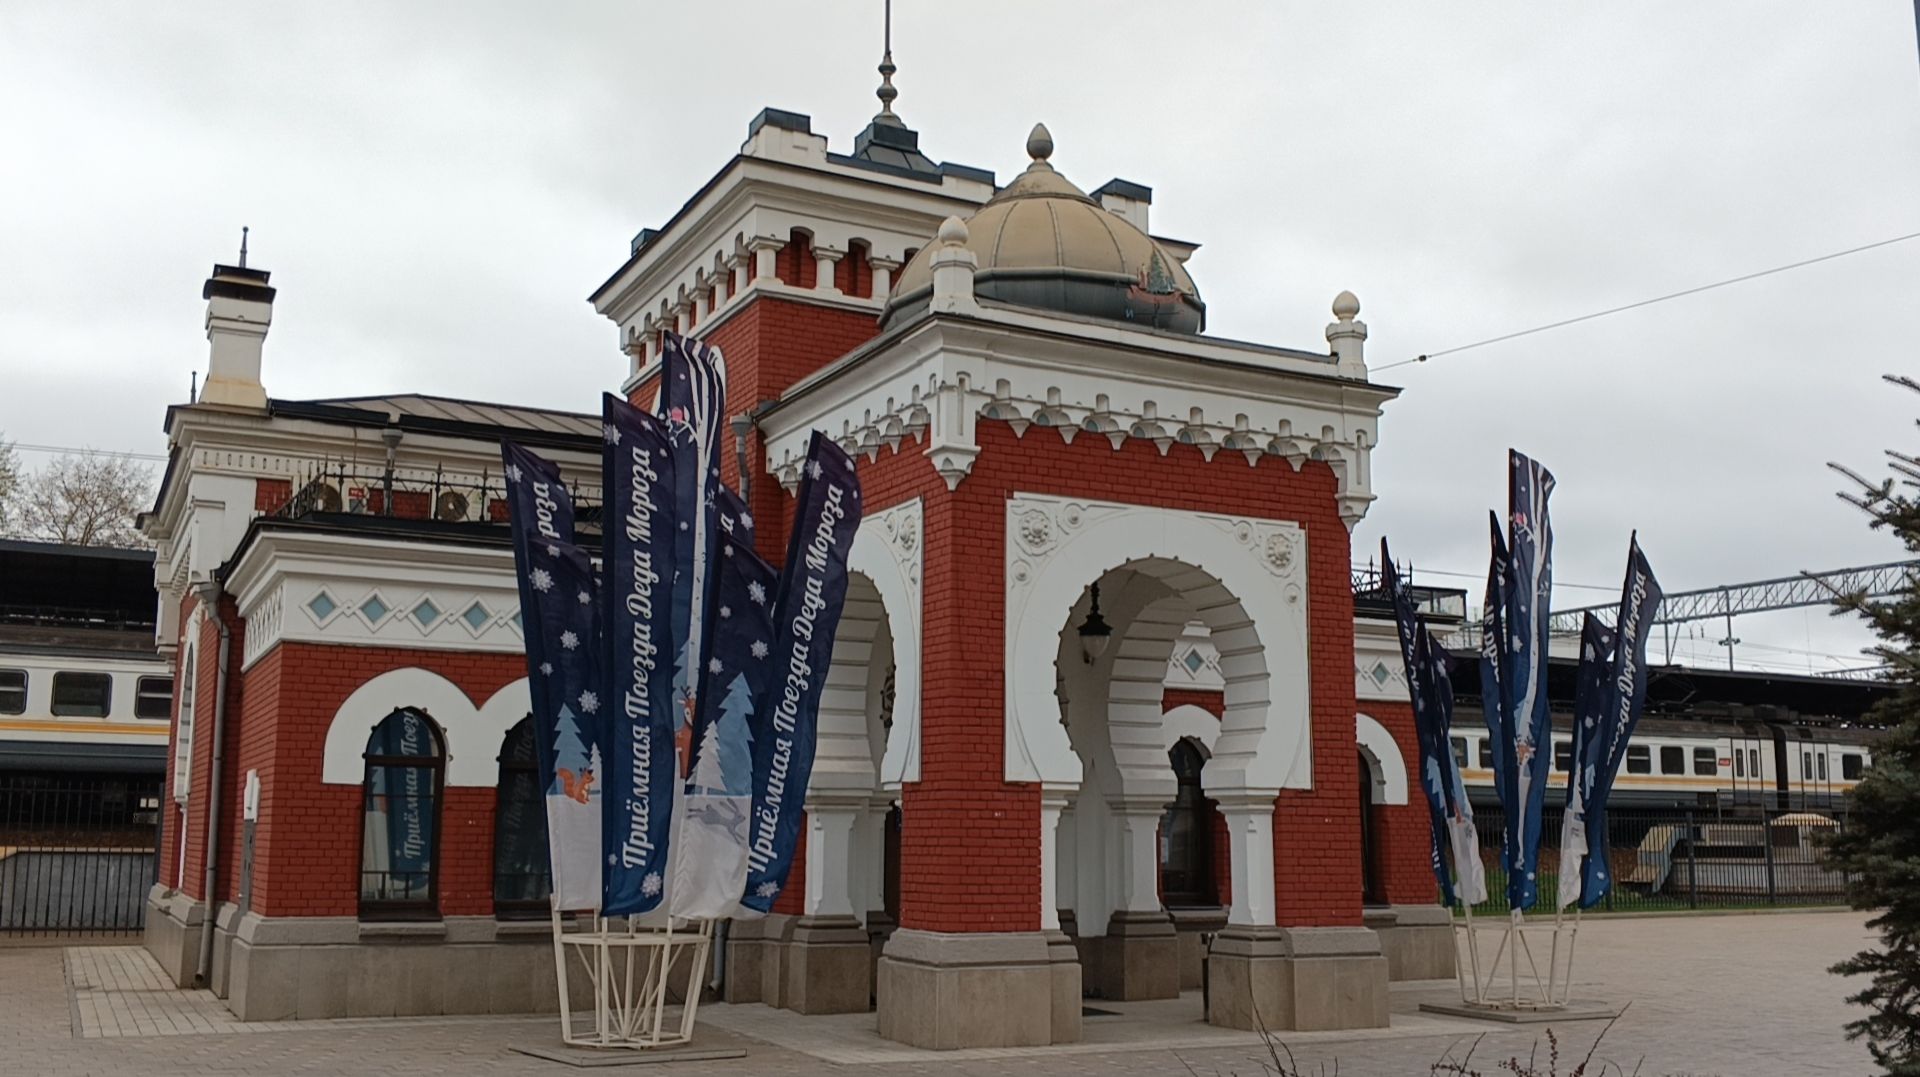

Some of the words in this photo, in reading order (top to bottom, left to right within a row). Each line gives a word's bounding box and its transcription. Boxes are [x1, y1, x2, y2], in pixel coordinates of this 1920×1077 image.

[533, 481, 561, 539] роза
[626, 446, 659, 545] Мороза
[805, 482, 845, 573] Мороза
[626, 549, 659, 620] Деда
[792, 575, 826, 642] Деда
[625, 621, 658, 719] Поезда
[773, 641, 812, 733] Поезда
[622, 724, 655, 869] Приёмная
[747, 736, 793, 874] Приёмная
